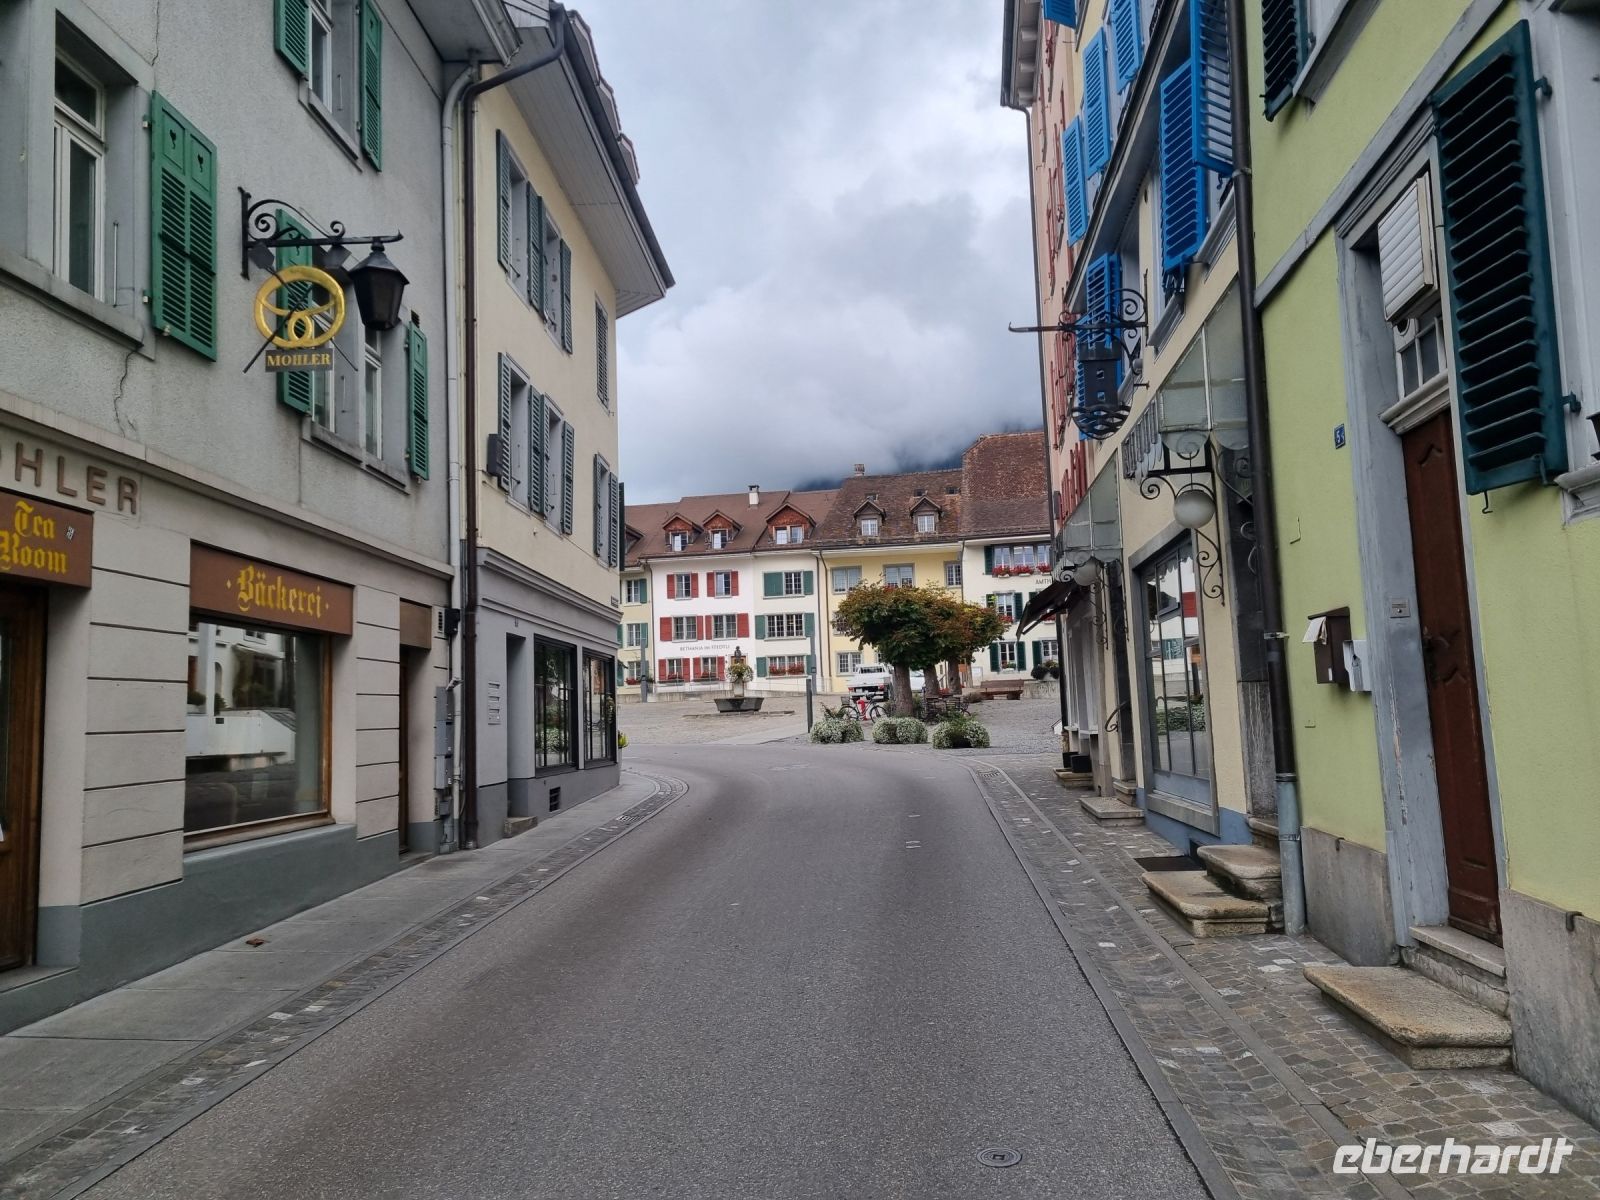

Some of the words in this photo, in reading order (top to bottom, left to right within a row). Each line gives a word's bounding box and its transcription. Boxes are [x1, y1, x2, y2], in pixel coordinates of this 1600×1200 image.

[267, 353, 331, 366] MOHLER
[0, 442, 138, 514] HLER
[15, 500, 56, 538] Tea
[0, 530, 68, 574] Room
[237, 565, 322, 619] Bäckerei
